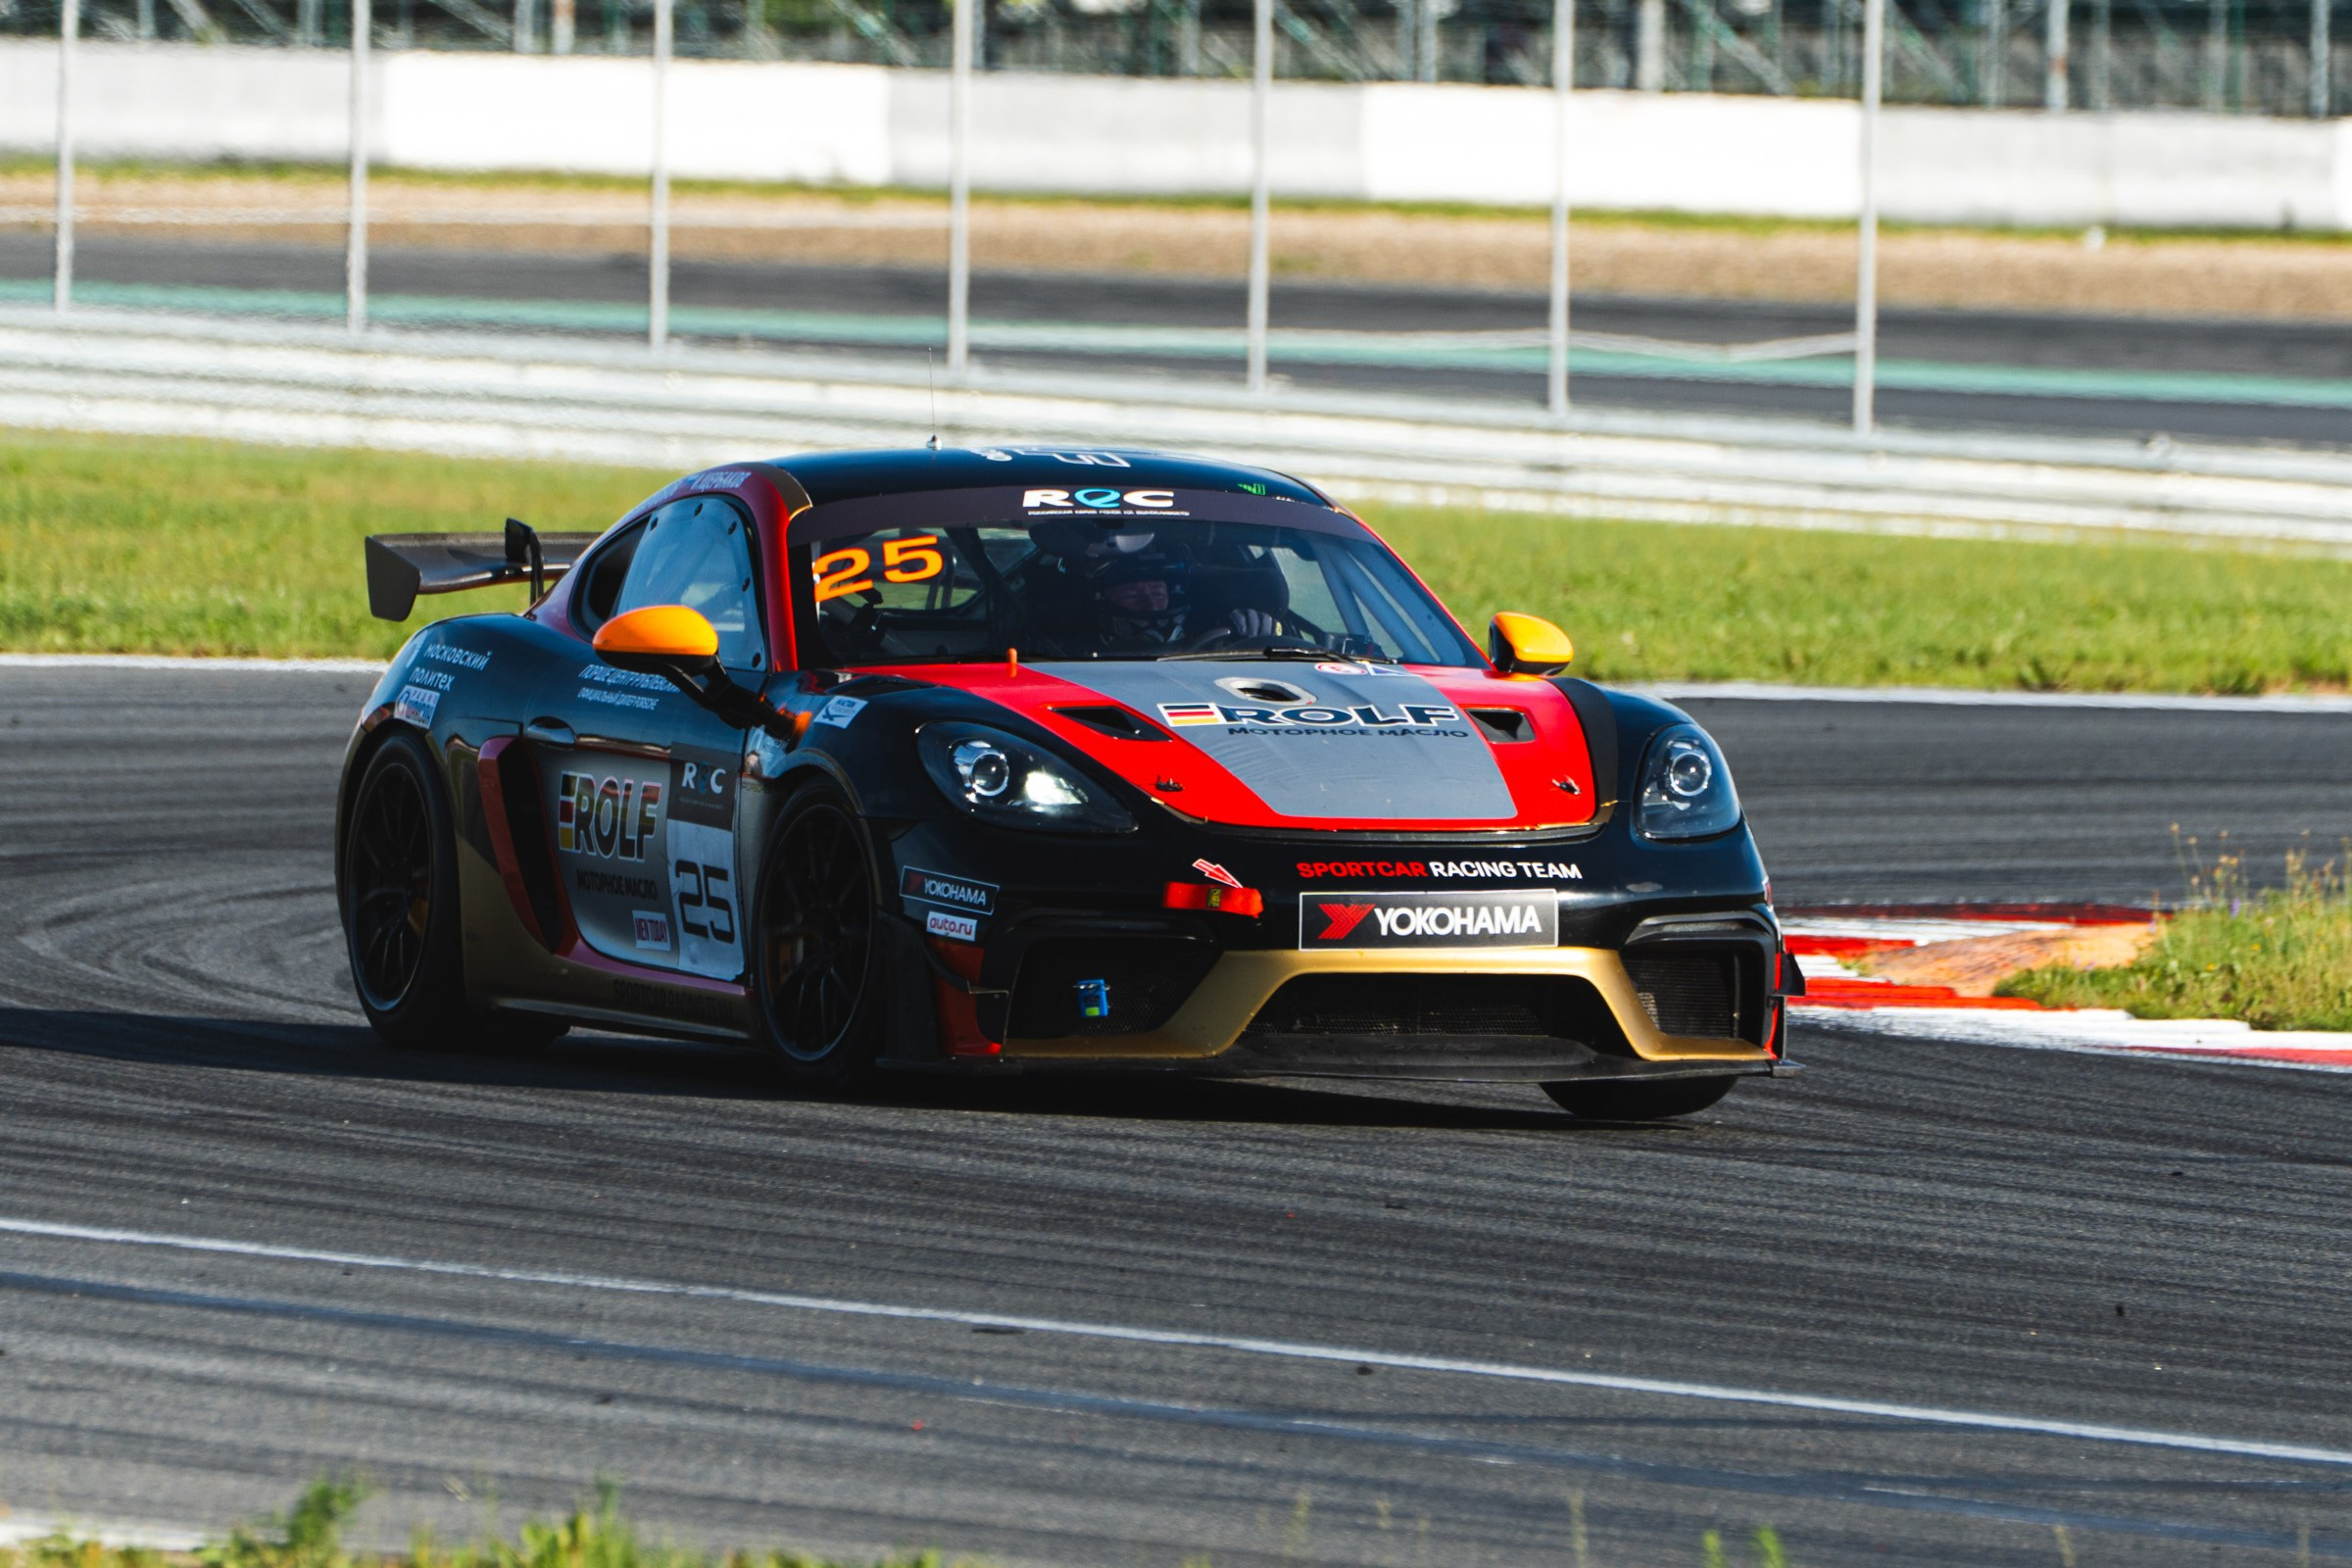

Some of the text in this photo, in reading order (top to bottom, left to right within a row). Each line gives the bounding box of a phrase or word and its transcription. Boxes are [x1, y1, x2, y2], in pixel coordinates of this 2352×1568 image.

[812, 534, 944, 603] 25
[1213, 704, 1459, 727] ROLF
[1228, 726, 1470, 738] МОТОРНОЕ МАСЛО
[573, 772, 662, 862] ROLF
[576, 869, 659, 901] МОТОРНОЕ МАСЛО
[1296, 860, 1584, 880] SPORTCAR RACING TEAM
[675, 859, 735, 945] 25
[924, 877, 988, 906] YOKOHAMA
[929, 916, 974, 936] auto.ru
[1373, 905, 1543, 936] YOKOHAMA
